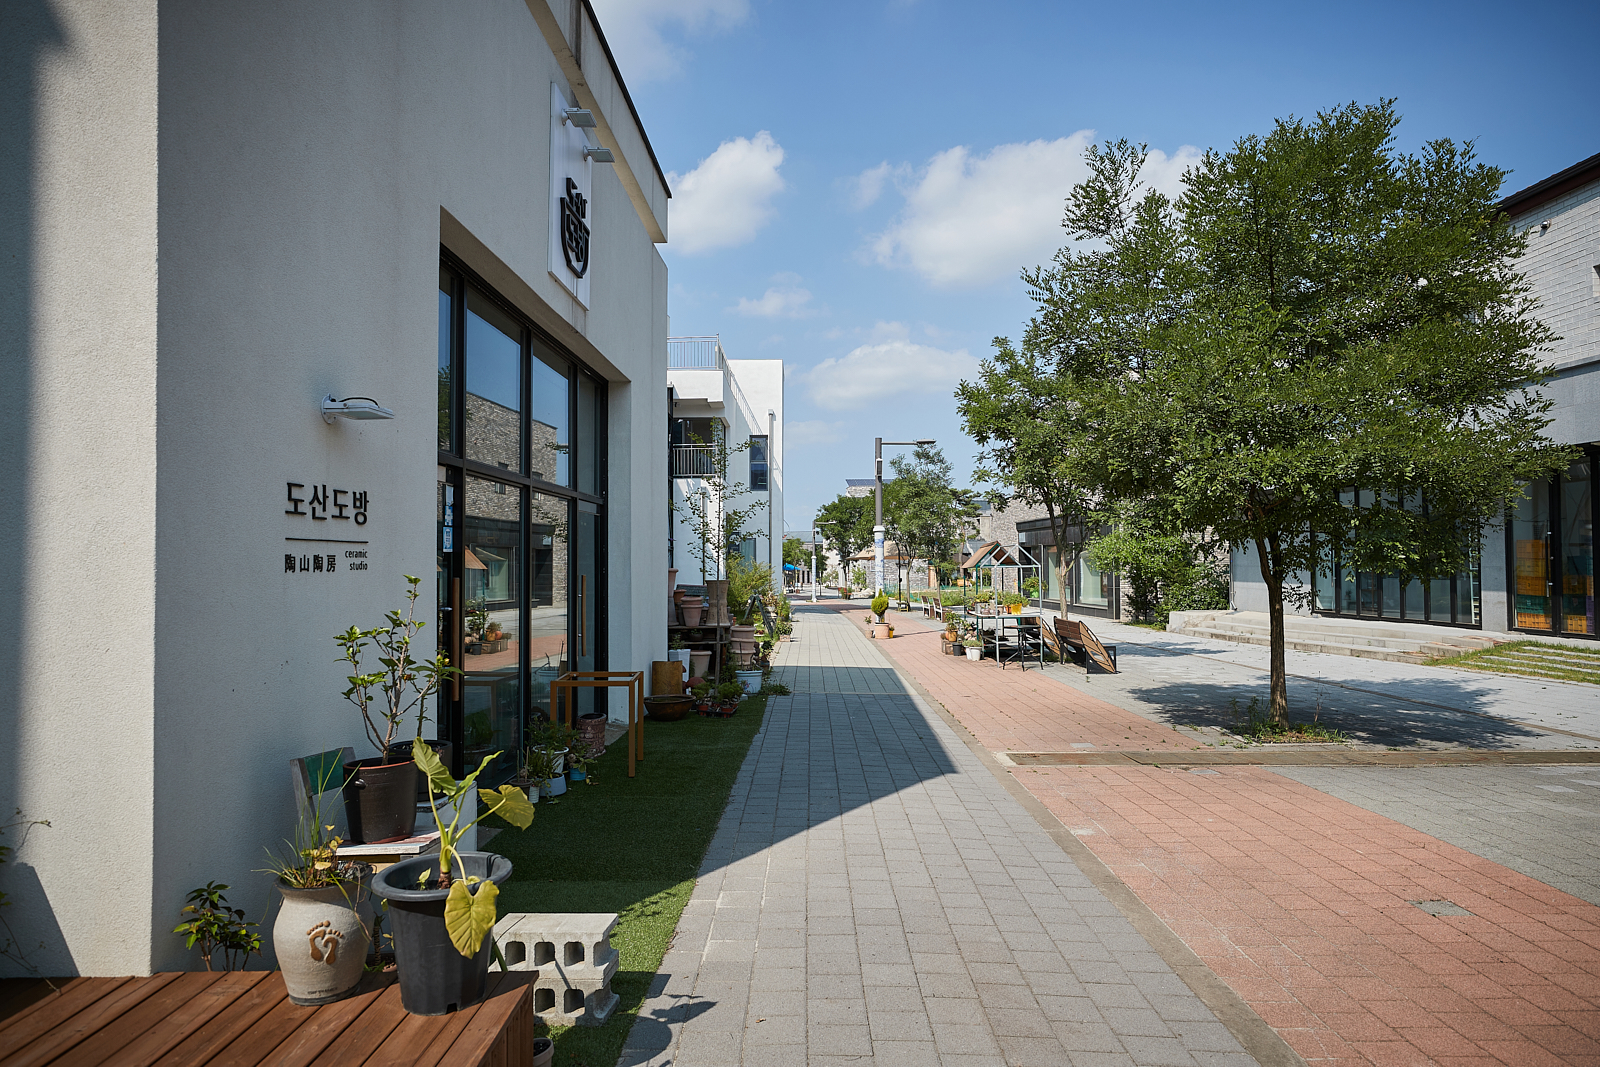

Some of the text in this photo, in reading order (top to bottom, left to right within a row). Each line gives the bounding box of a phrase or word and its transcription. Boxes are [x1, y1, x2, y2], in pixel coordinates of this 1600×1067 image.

[285, 482, 369, 525] 도산도방
[345, 549, 368, 558] ceramic
[284, 554, 336, 573] 陶山陶房
[349, 561, 368, 571] studio
